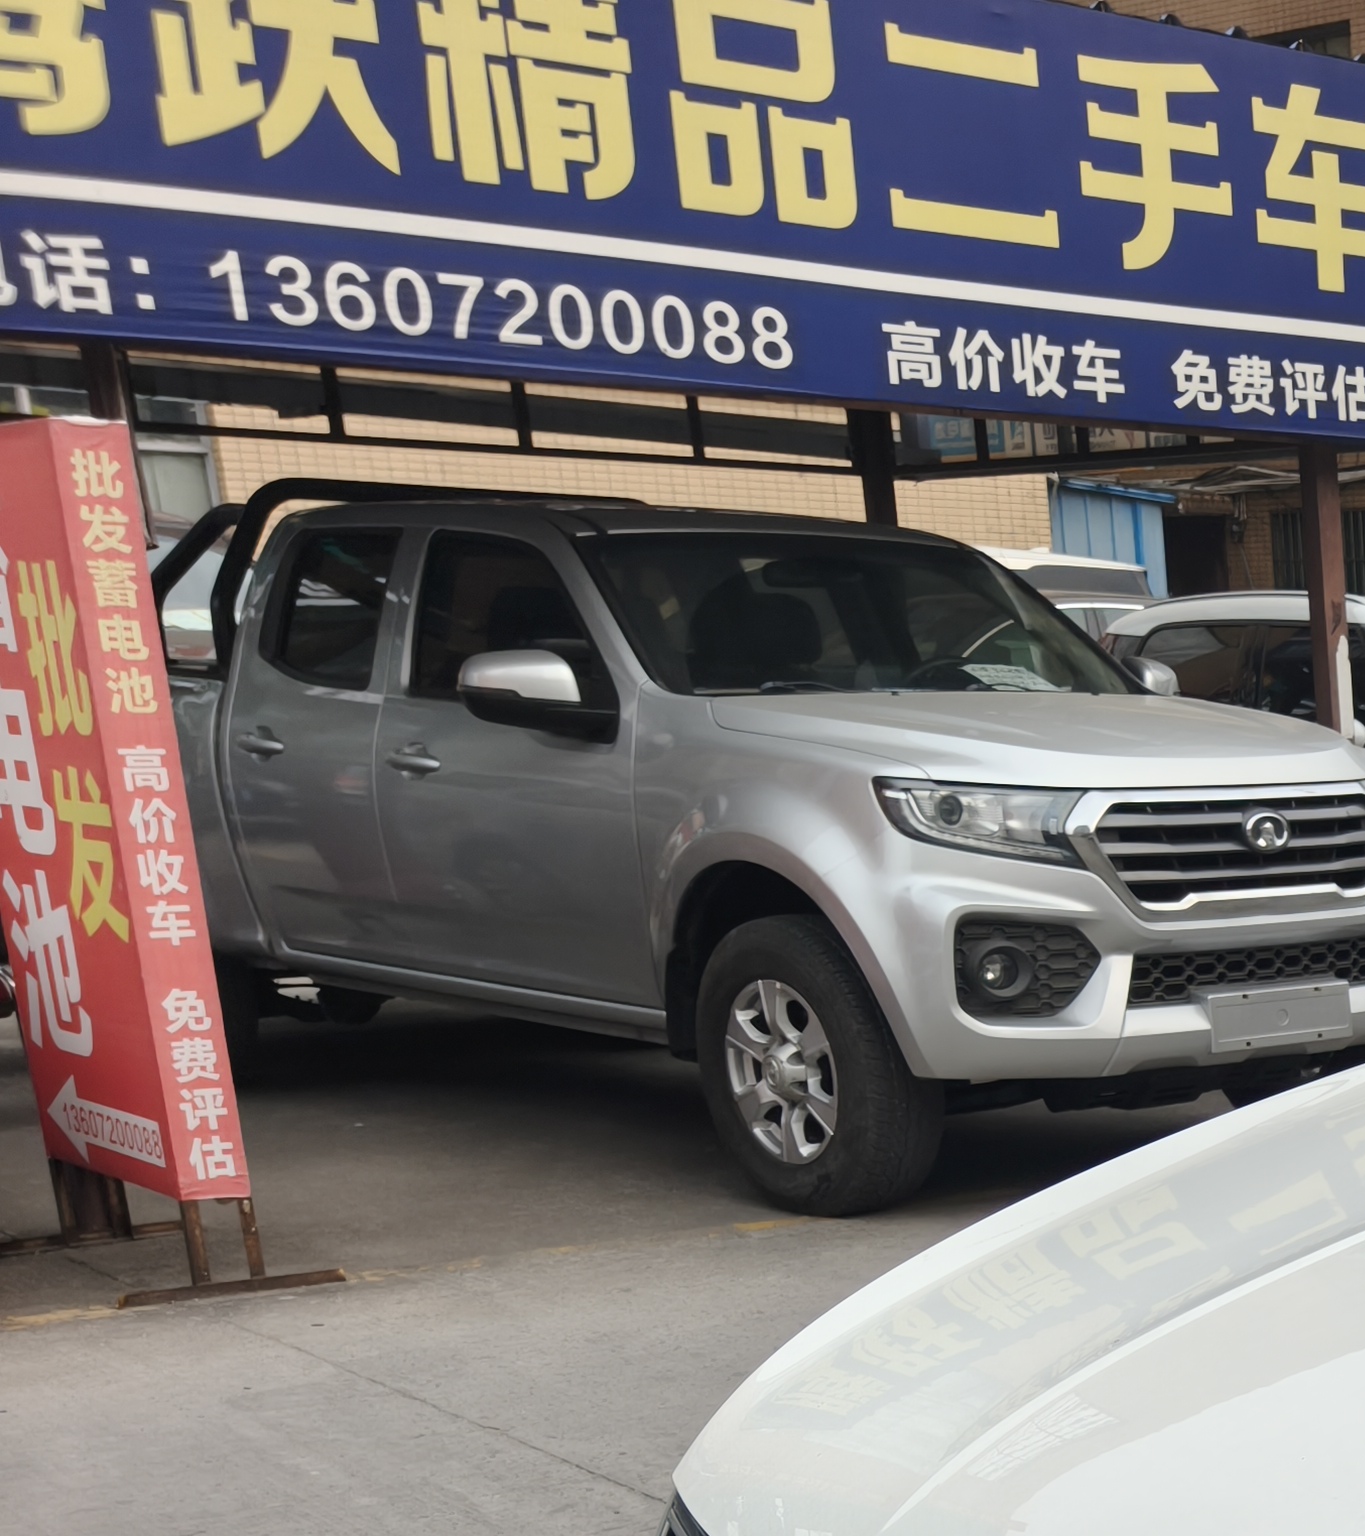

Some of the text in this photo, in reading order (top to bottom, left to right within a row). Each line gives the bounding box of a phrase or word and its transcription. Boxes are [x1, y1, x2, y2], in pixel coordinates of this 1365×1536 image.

[209, 250, 794, 370] 13607200088
[881, 320, 1126, 403] 高价收车
[17, 560, 130, 945] 批发
[70, 447, 238, 1183] 批发蓄电池 高价收车 免费评估
[63, 1102, 163, 1160] 13607200088
